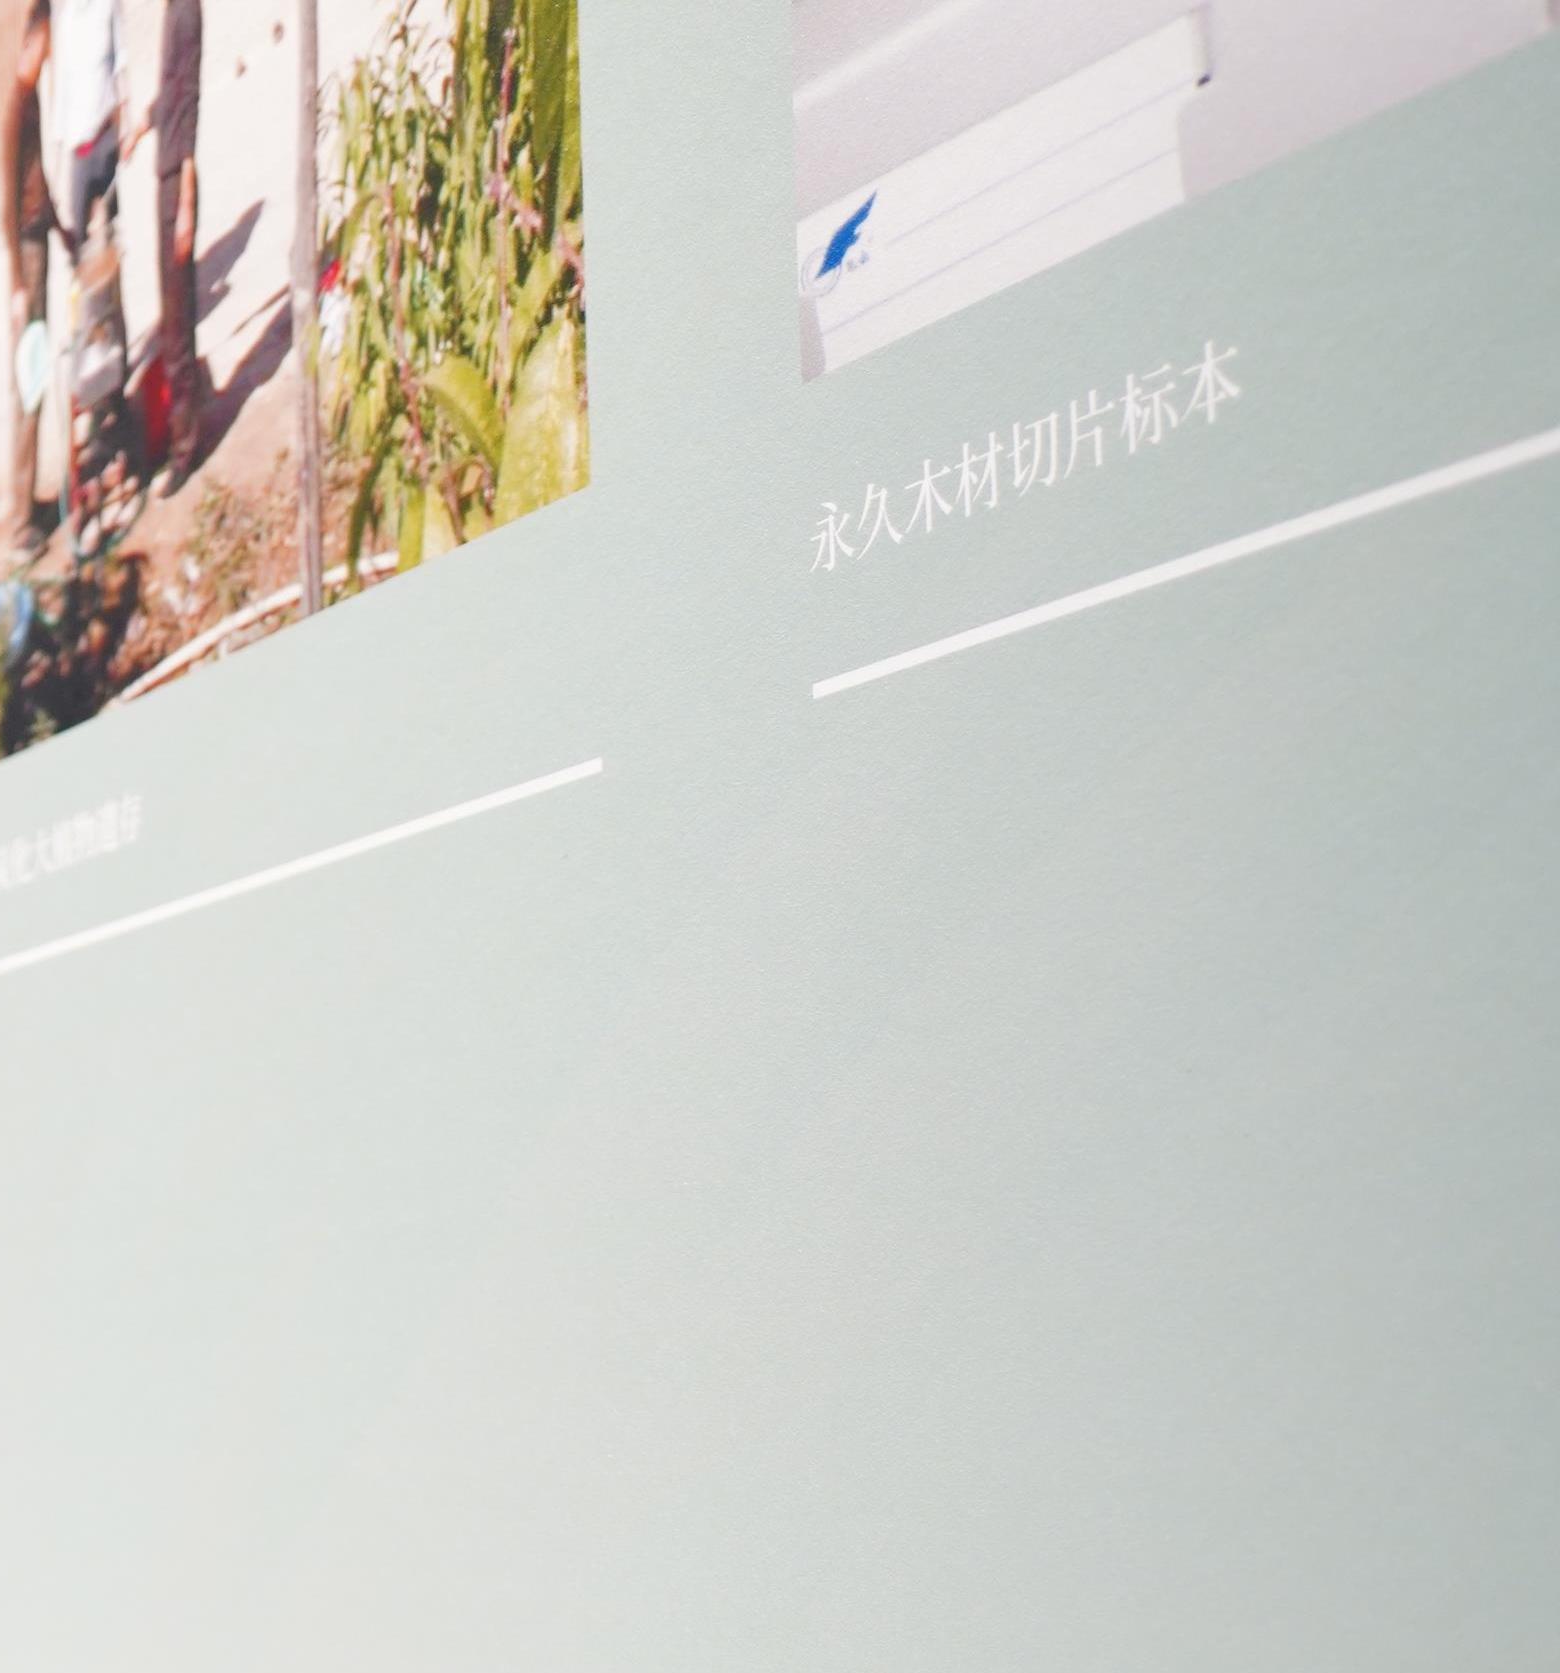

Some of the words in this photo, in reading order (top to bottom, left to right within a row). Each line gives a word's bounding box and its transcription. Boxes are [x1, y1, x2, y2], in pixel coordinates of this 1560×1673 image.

[809, 339, 1240, 574] 永久木材切片标本
